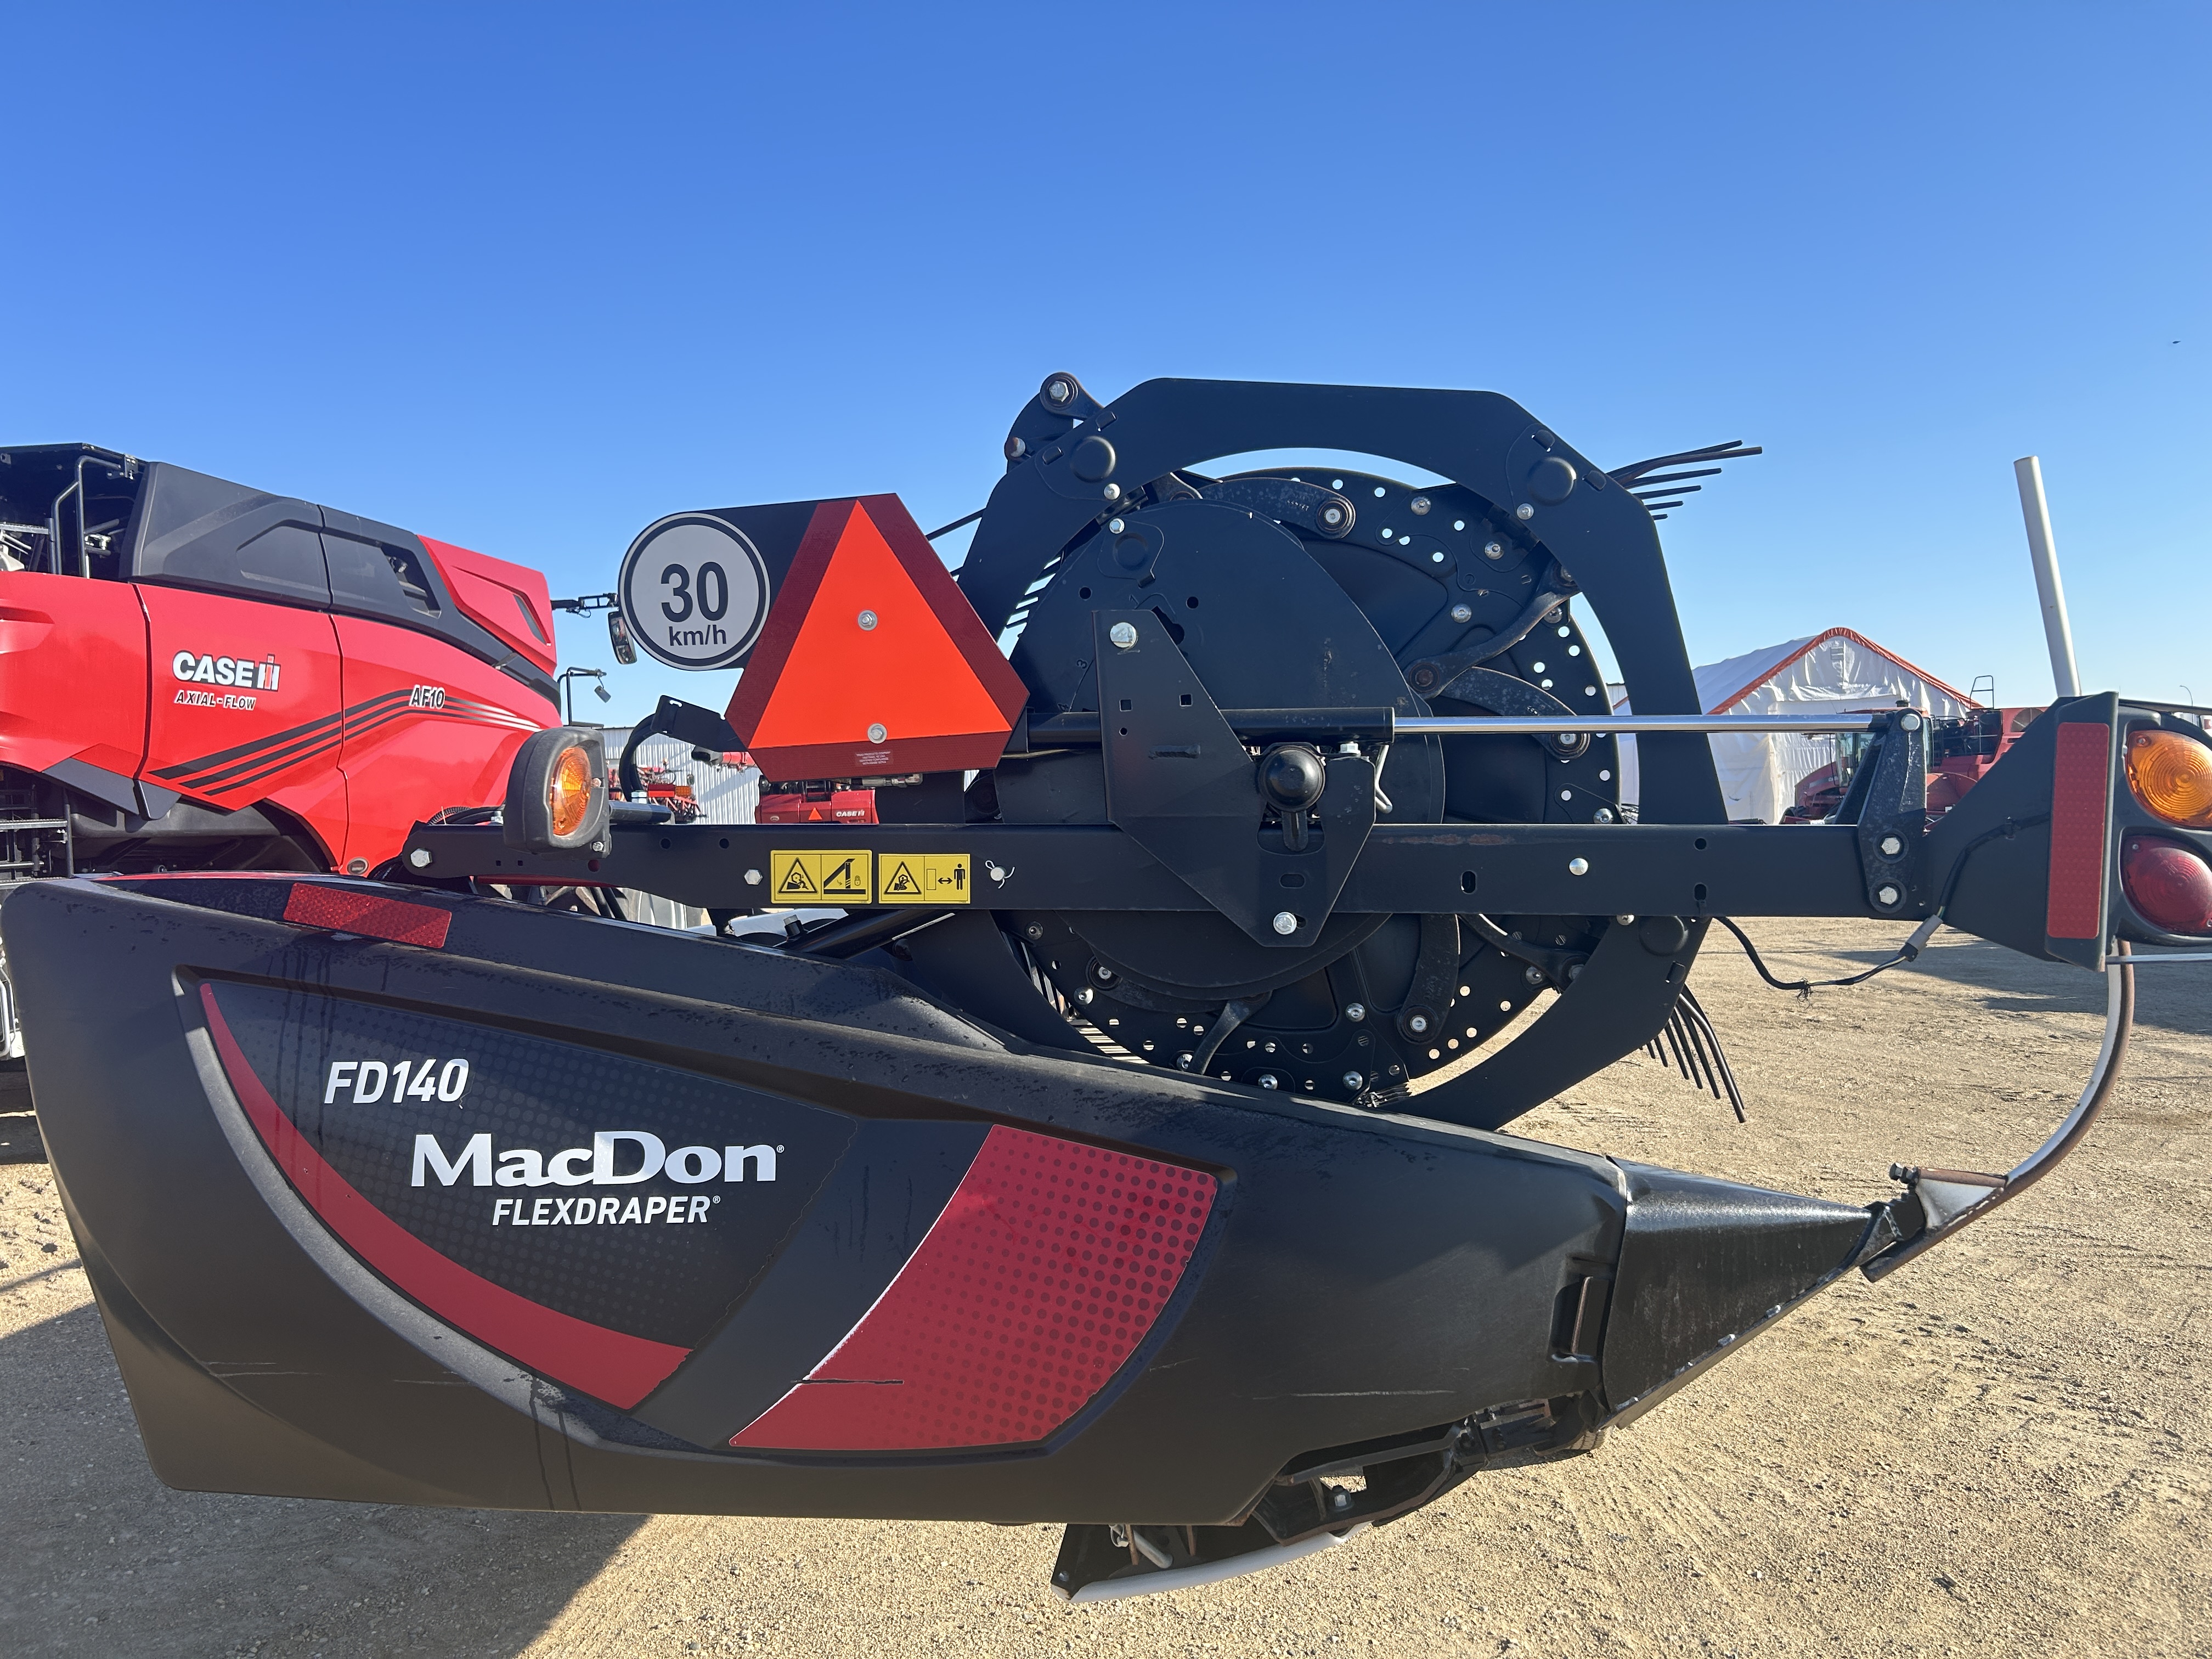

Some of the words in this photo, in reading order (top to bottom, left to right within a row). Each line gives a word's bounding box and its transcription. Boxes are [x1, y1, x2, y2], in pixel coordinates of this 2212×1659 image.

[661, 561, 729, 623] 30
[669, 624, 727, 646] km/h
[172, 650, 255, 688] CASE
[174, 690, 257, 711] AXIAL-FLOW
[409, 685, 445, 710] AF10
[324, 1058, 469, 1104] FD140
